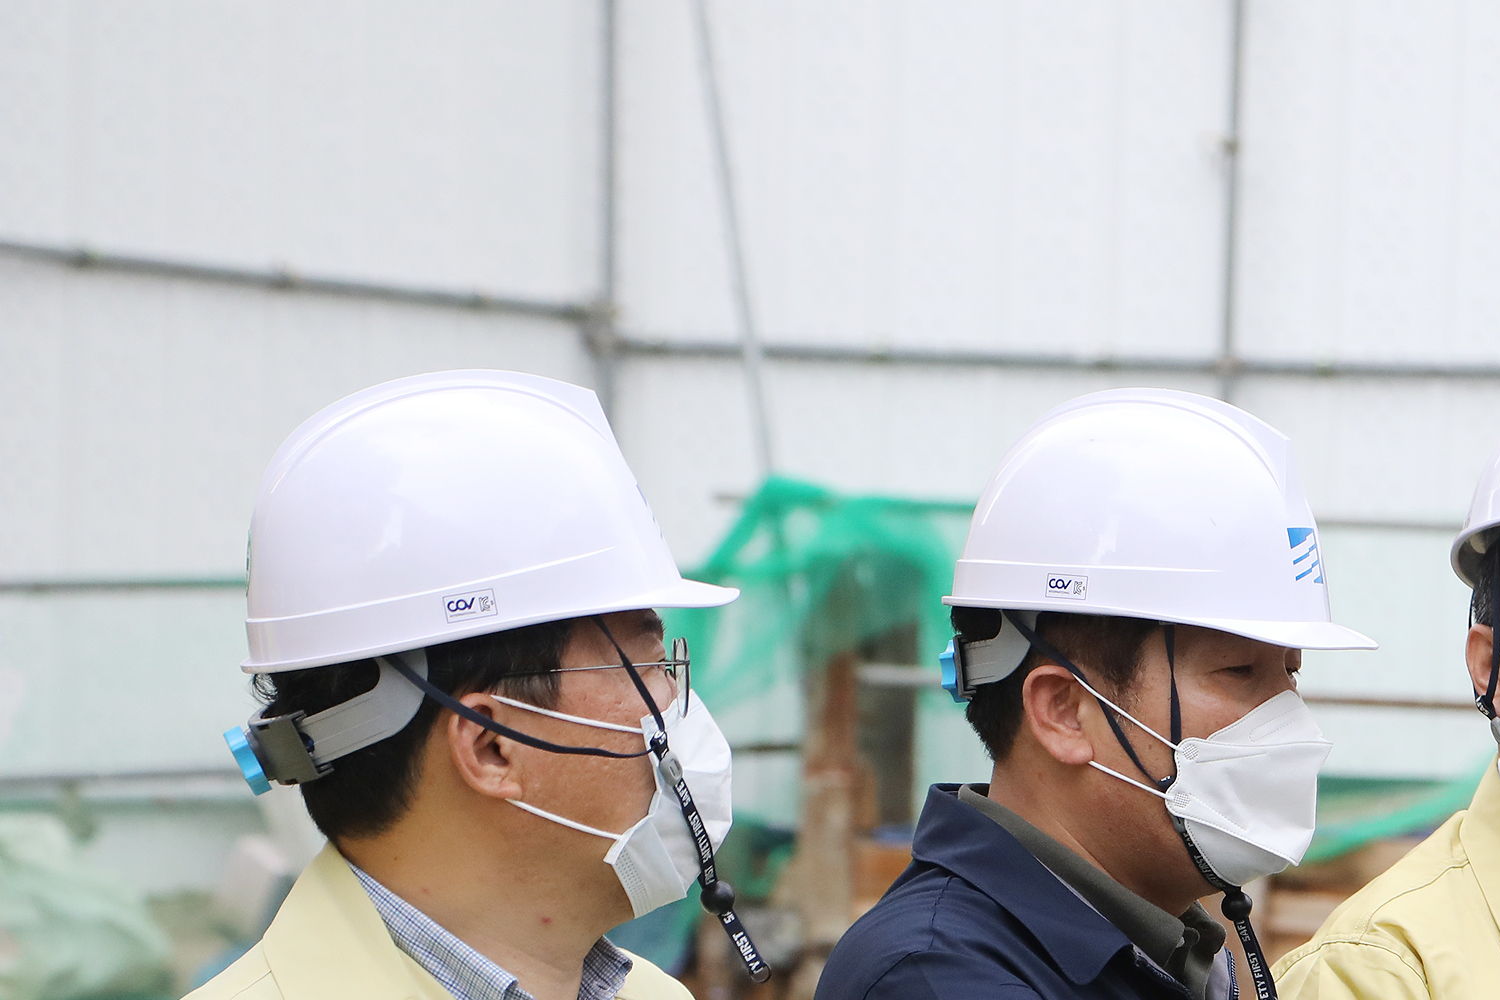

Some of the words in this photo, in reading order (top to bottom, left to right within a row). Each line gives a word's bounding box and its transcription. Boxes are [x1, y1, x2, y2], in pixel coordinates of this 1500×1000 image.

[688, 811, 704, 837] FIRST
[697, 833, 712, 863] SAFETY
[733, 931, 756, 962] FIRST
[1248, 952, 1263, 979] FIRST
